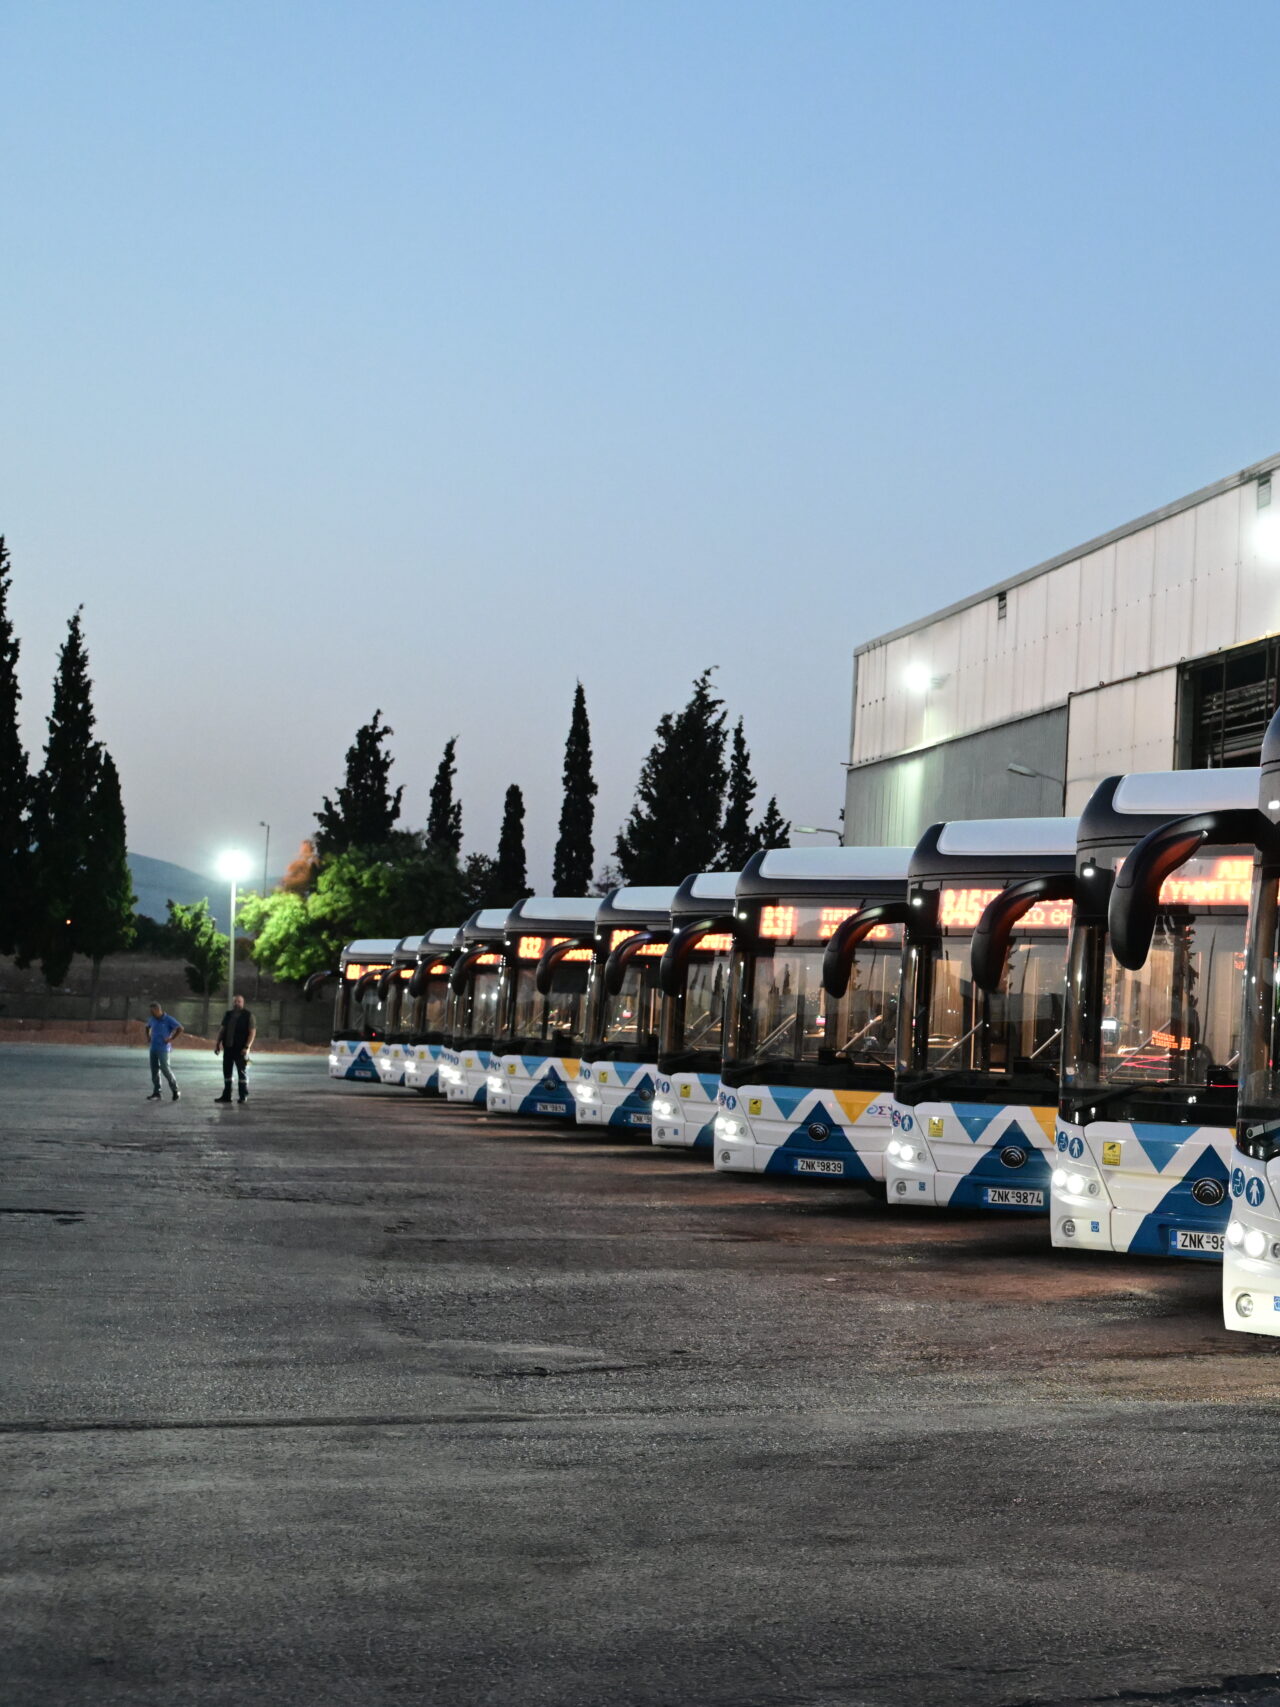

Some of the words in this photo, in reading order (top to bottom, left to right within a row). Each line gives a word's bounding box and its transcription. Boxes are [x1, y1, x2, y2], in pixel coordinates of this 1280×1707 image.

[800, 1159, 842, 1173] ZNK-9839
[991, 1189, 1042, 1205] ZNK-9874
[1180, 1232, 1225, 1251] ZNK-98
